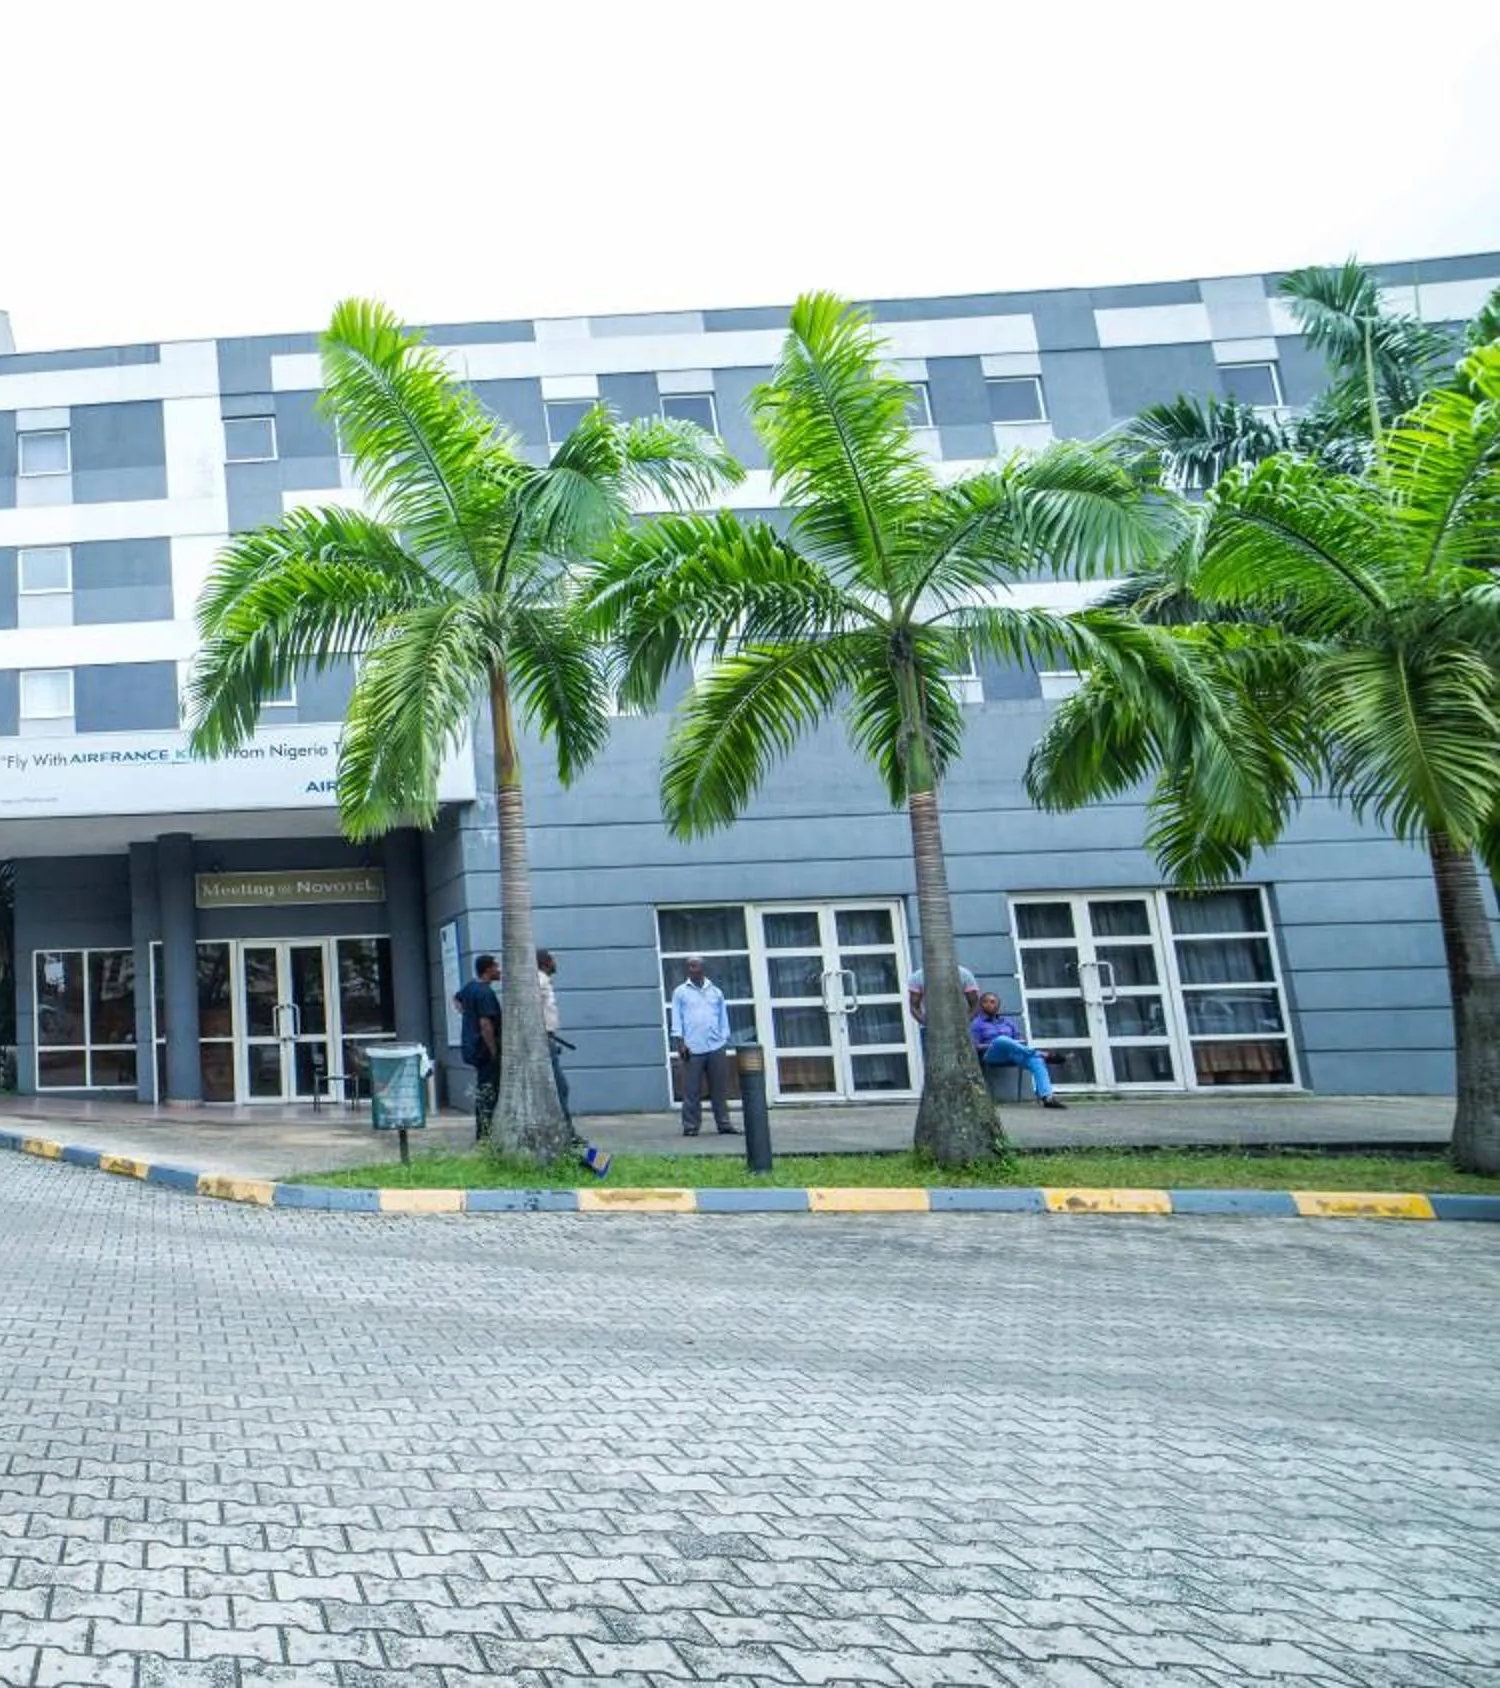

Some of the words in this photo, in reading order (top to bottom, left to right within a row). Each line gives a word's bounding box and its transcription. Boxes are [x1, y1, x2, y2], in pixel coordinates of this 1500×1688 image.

[33, 752, 67, 767] With
[70, 749, 169, 764] AIRFRANCE
[270, 744, 329, 760] Nigeria
[306, 781, 339, 793] AIR
[202, 882, 275, 897] Meeting
